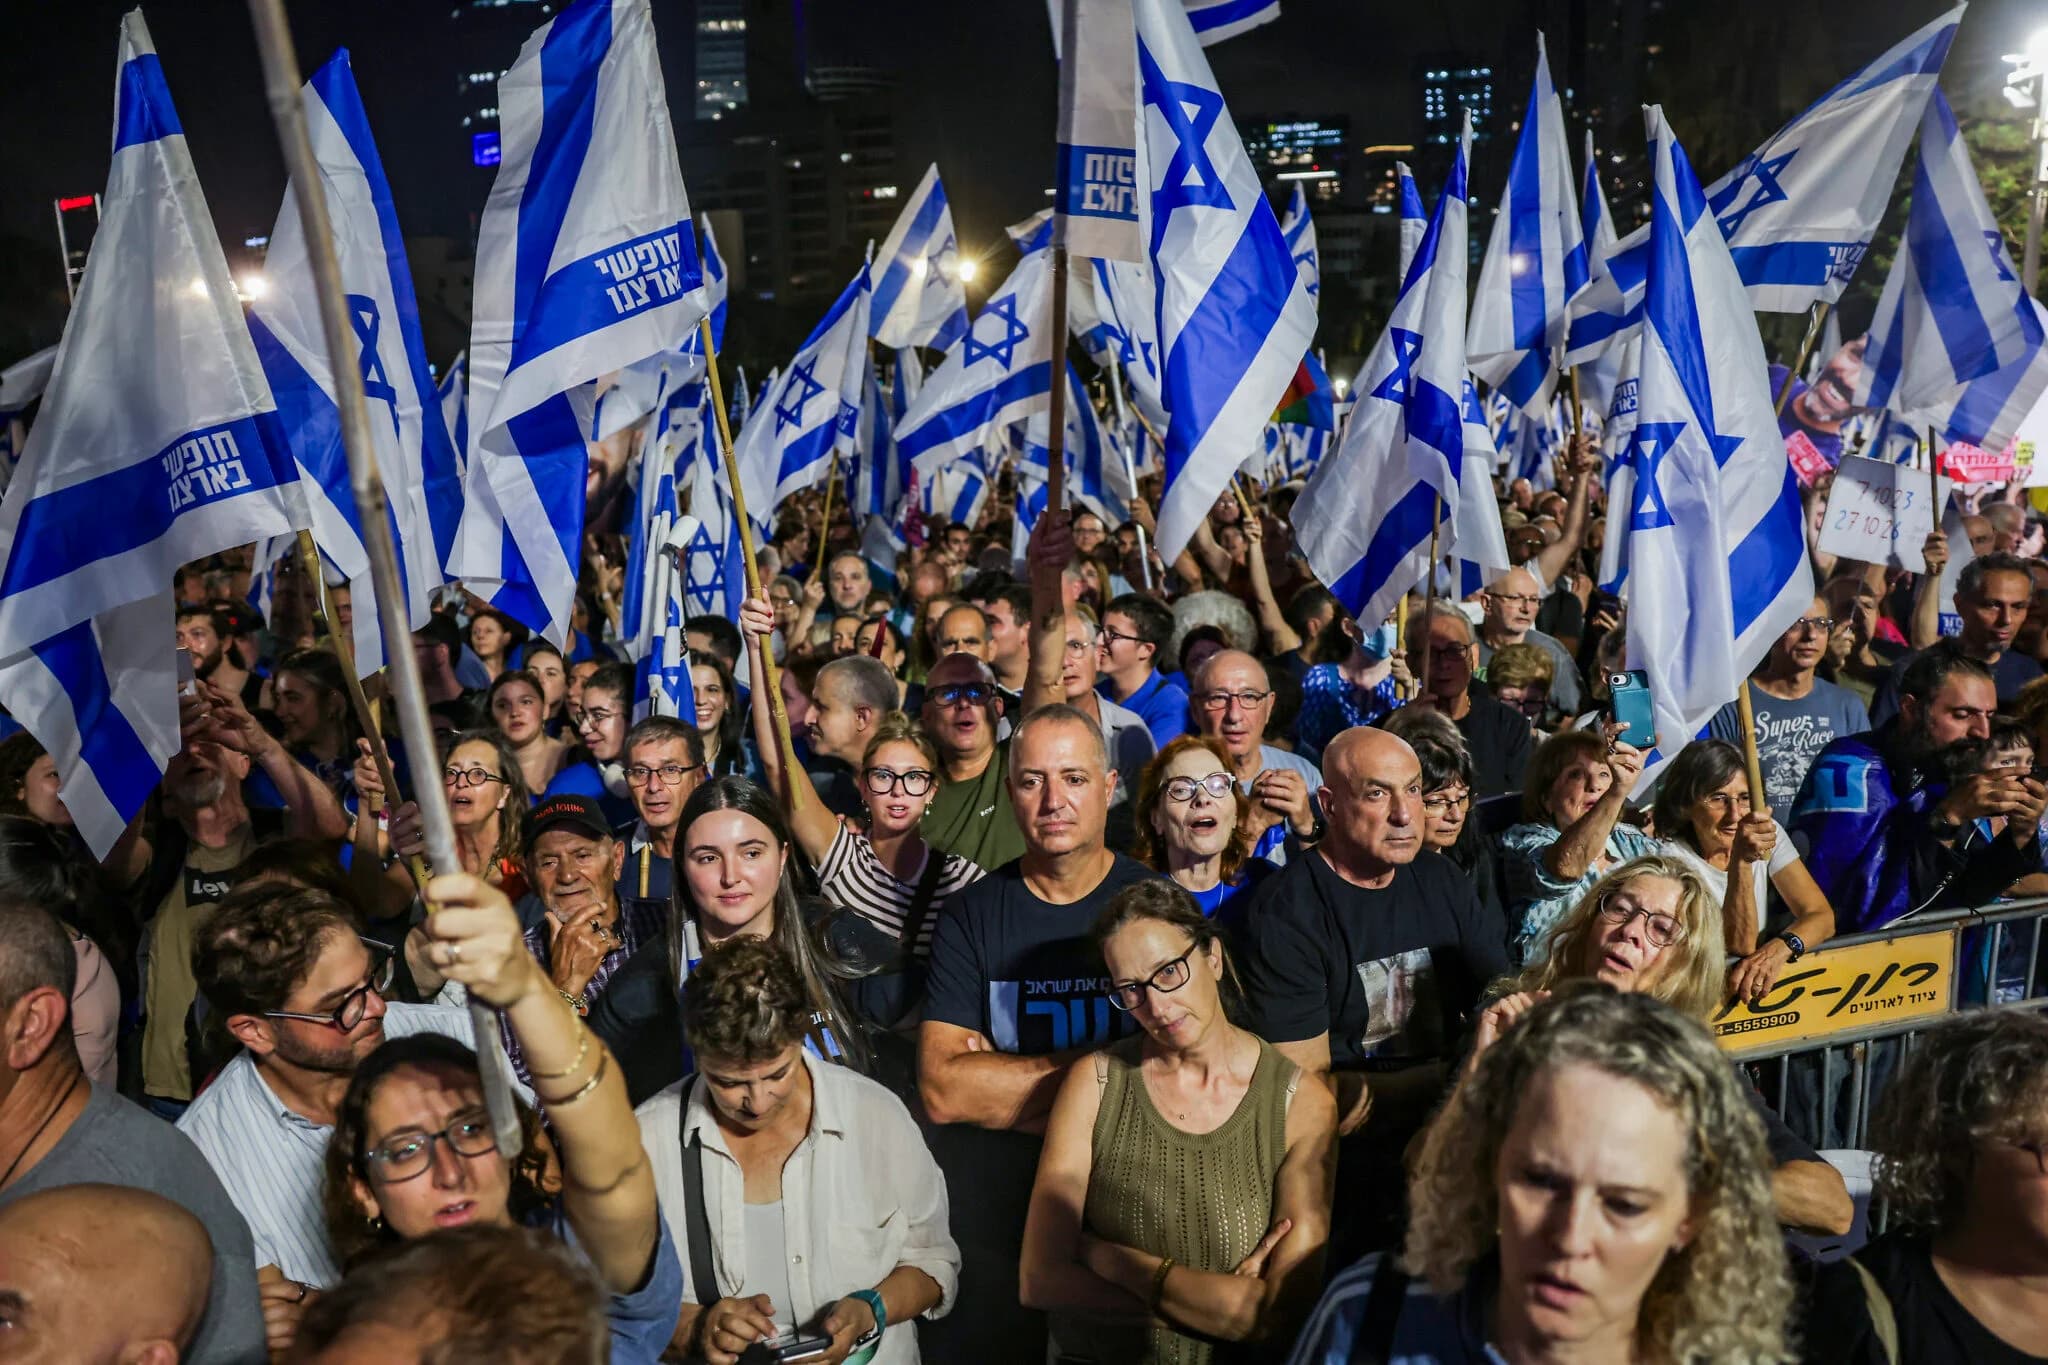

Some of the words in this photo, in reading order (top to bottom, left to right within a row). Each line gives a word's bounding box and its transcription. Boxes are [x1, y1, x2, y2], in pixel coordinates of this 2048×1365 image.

[594, 232, 680, 282] חופשי
[605, 263, 682, 314] ארצנו
[161, 430, 241, 481] חופשי
[167, 459, 252, 513] בארצנו
[1754, 711, 1814, 745] Super
[1793, 728, 1835, 752] Race
[1025, 979, 1072, 995] ישראל
[1074, 977, 1097, 992] את
[1849, 995, 1904, 1014] לארועים
[1909, 990, 1938, 1005] ציוד
[1713, 1012, 1798, 1036] 4-5559900
